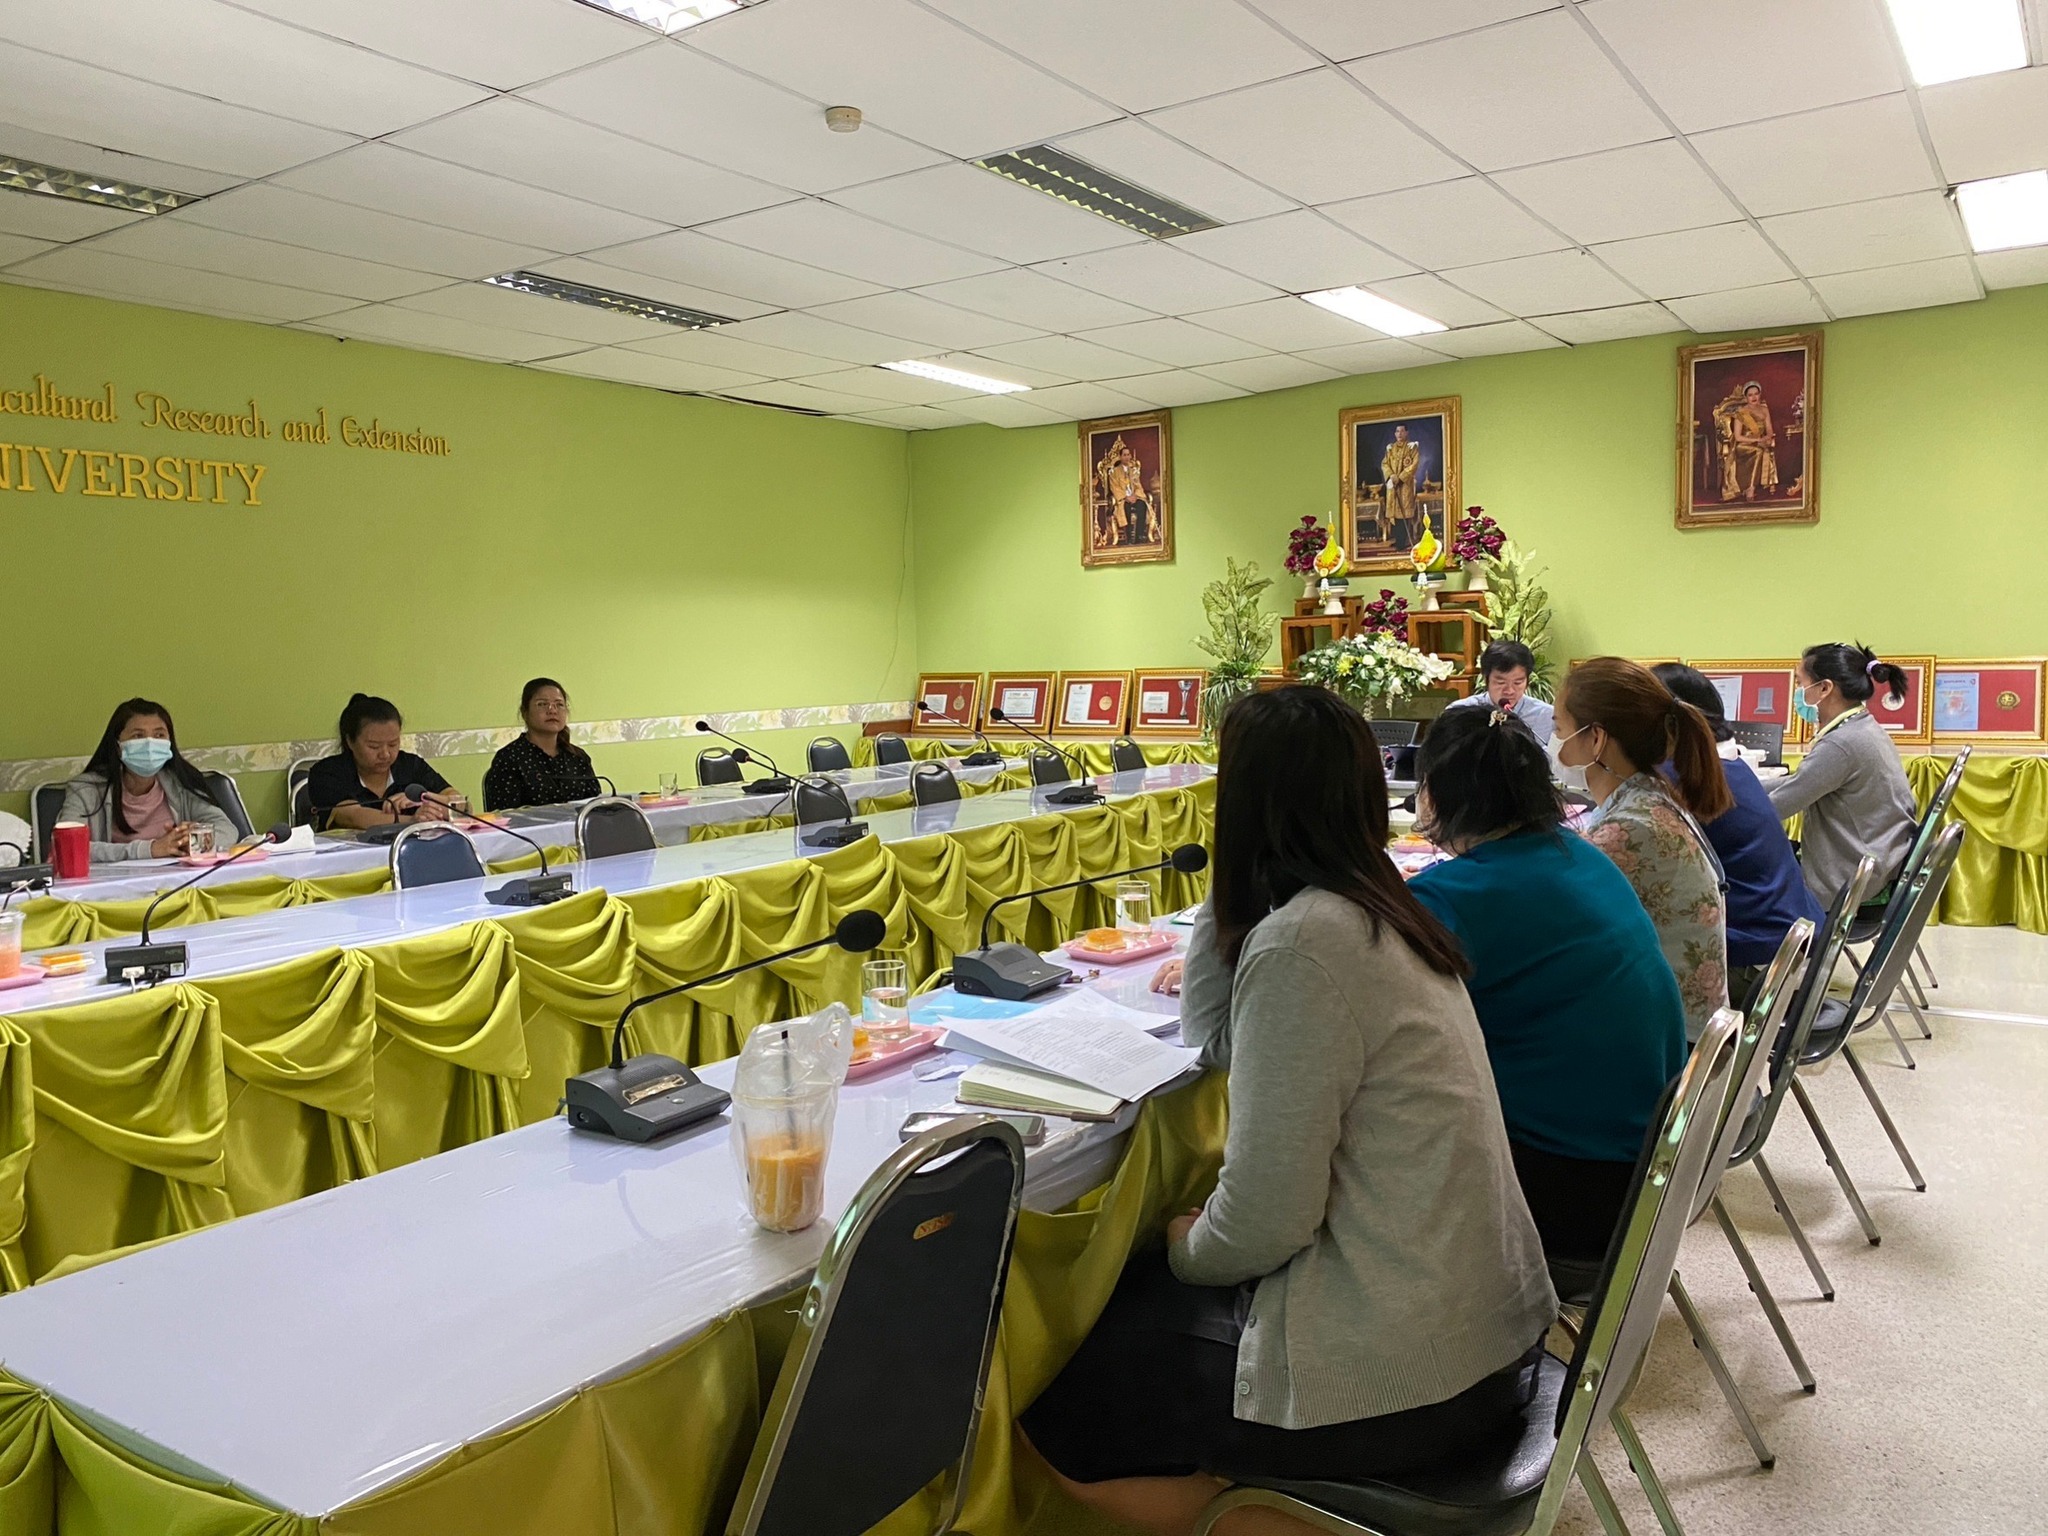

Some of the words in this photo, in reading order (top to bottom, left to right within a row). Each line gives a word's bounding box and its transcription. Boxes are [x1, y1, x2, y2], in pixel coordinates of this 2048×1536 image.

[0, 374, 118, 422] cultural
[136, 391, 271, 439] Research
[284, 407, 331, 445] and
[341, 416, 451, 456] Extension
